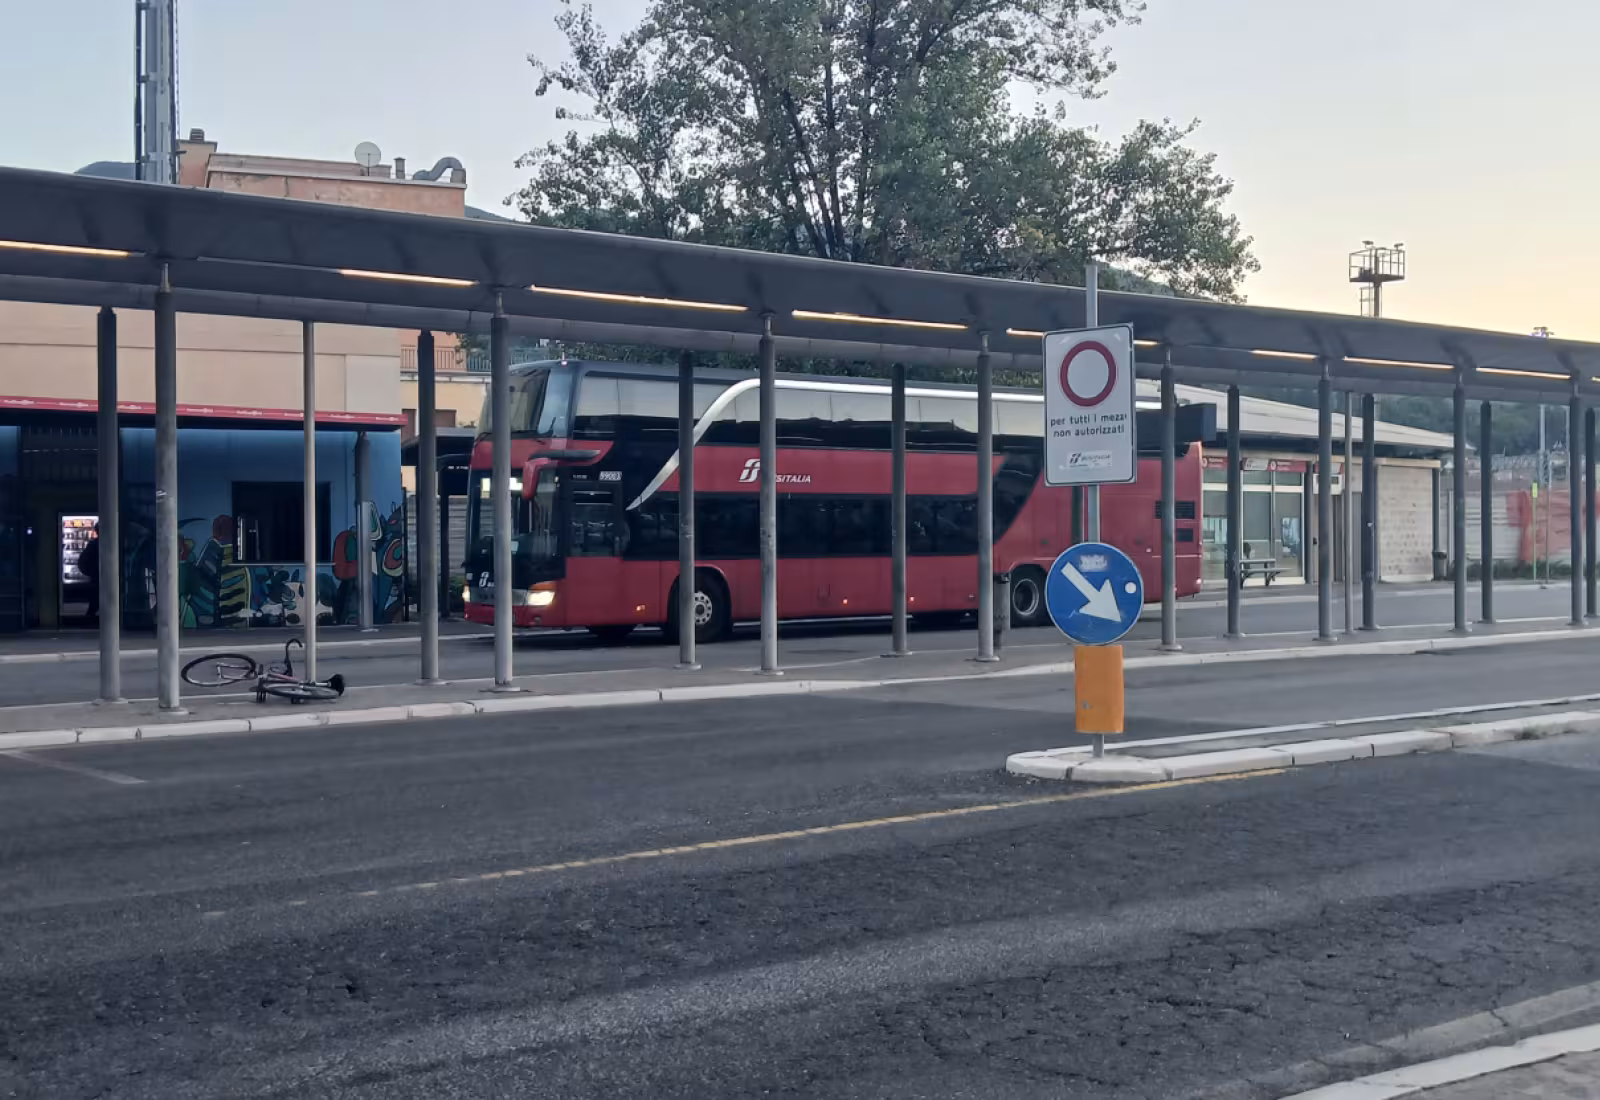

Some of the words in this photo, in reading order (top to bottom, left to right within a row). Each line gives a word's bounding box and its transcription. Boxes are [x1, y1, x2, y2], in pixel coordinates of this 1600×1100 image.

[1050, 417, 1066, 428] per
[1069, 413, 1090, 424] tutti
[1053, 429, 1072, 438] non
[1074, 424, 1125, 436] autorizzati
[775, 474, 811, 483] SITALIA
